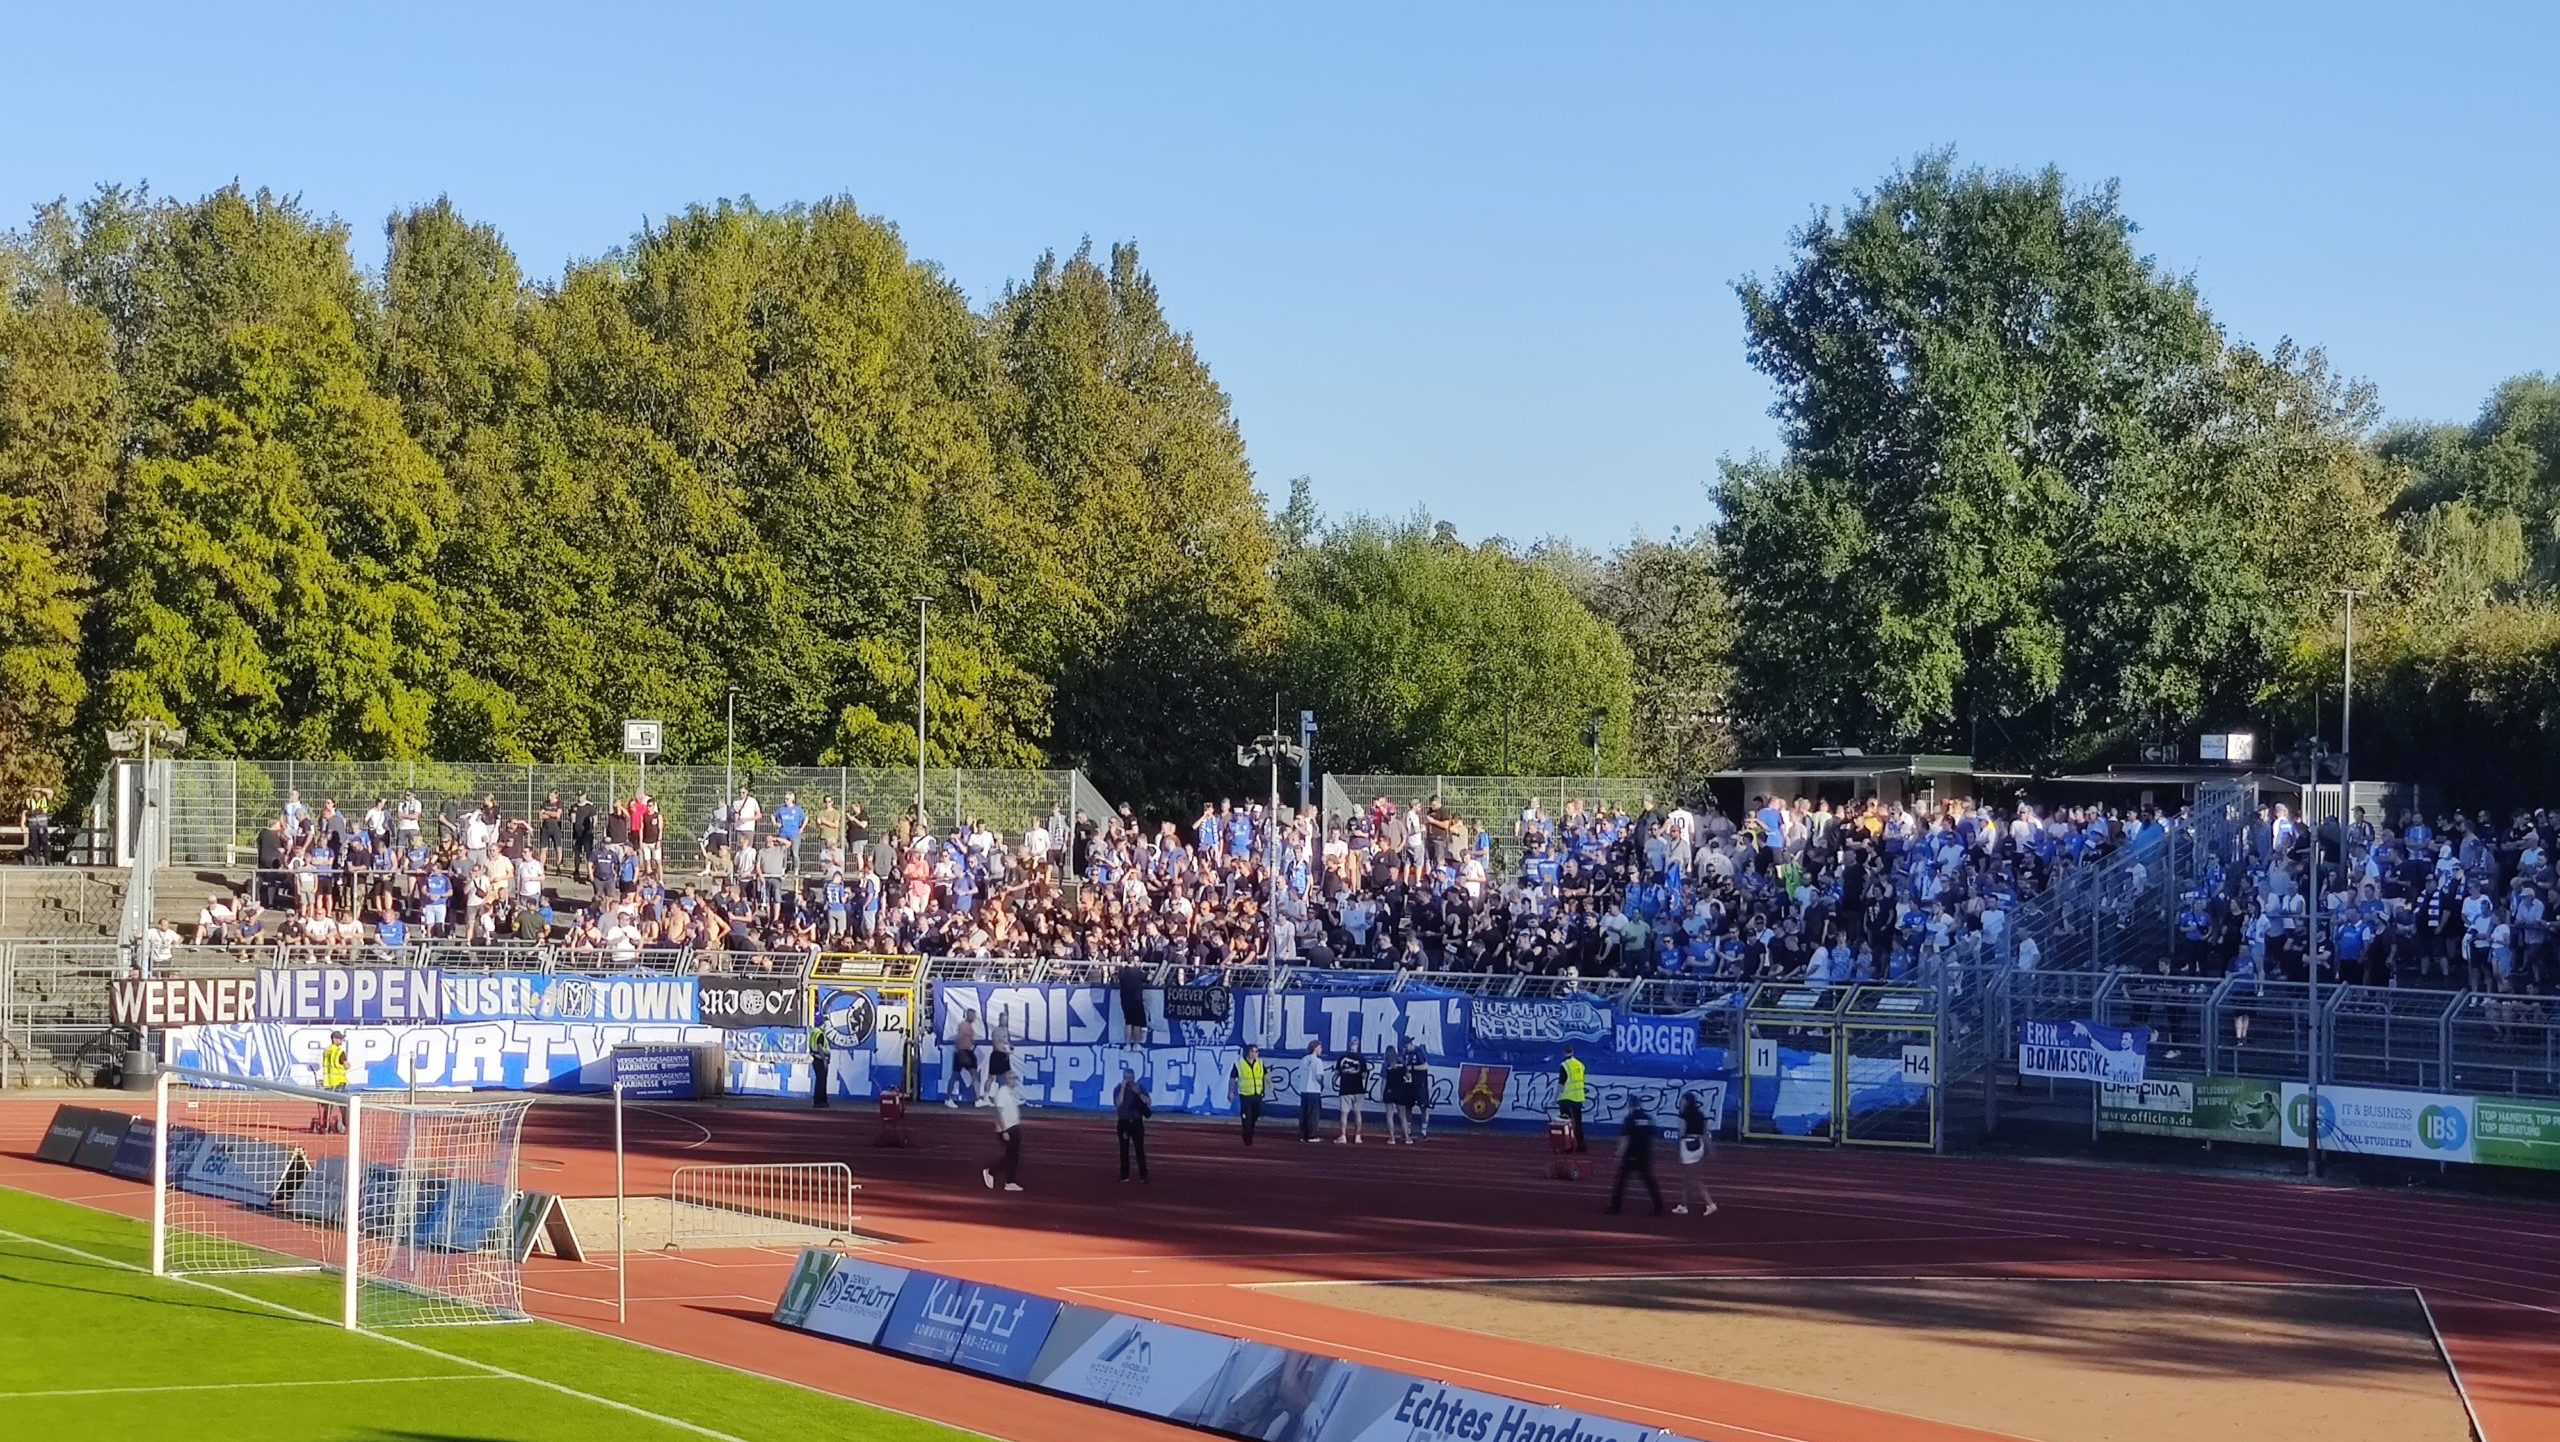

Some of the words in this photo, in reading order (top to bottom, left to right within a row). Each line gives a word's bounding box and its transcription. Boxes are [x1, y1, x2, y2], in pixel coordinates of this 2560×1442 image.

[112, 979, 257, 1024] WEENER
[260, 968, 442, 1018] MEPPEN
[441, 976, 534, 1017] FUSEL
[590, 981, 693, 1021] TOWN
[1167, 987, 1204, 1002] FOREVER
[883, 1013, 901, 1031] 12
[1475, 1014, 1564, 1041] REBELS
[2026, 1021, 2059, 1047] ERIK
[1615, 1017, 1695, 1056] BÖRGER
[616, 1056, 689, 1065] VERSICHERUNGSAGENTUR
[1904, 1054, 1929, 1075] H4
[2026, 1047, 2110, 1077] DOMASCHKE
[2100, 1110, 2193, 1126] www.officina.de
[2363, 1105, 2413, 1120] BUSINESS
[2480, 1110, 2498, 1121] TOP
[2535, 1114, 2551, 1126] TOP
[2427, 1115, 2457, 1140] IBS
[2480, 1121, 2498, 1133] TOP
[2498, 1123, 2541, 1137] BERATUNG
[2364, 1135, 2413, 1149] STUDIEREN
[840, 1283, 896, 1310] SCHÜTT
[920, 1277, 1027, 1339] Kuhnt
[1394, 1381, 1493, 1442] Echtes
